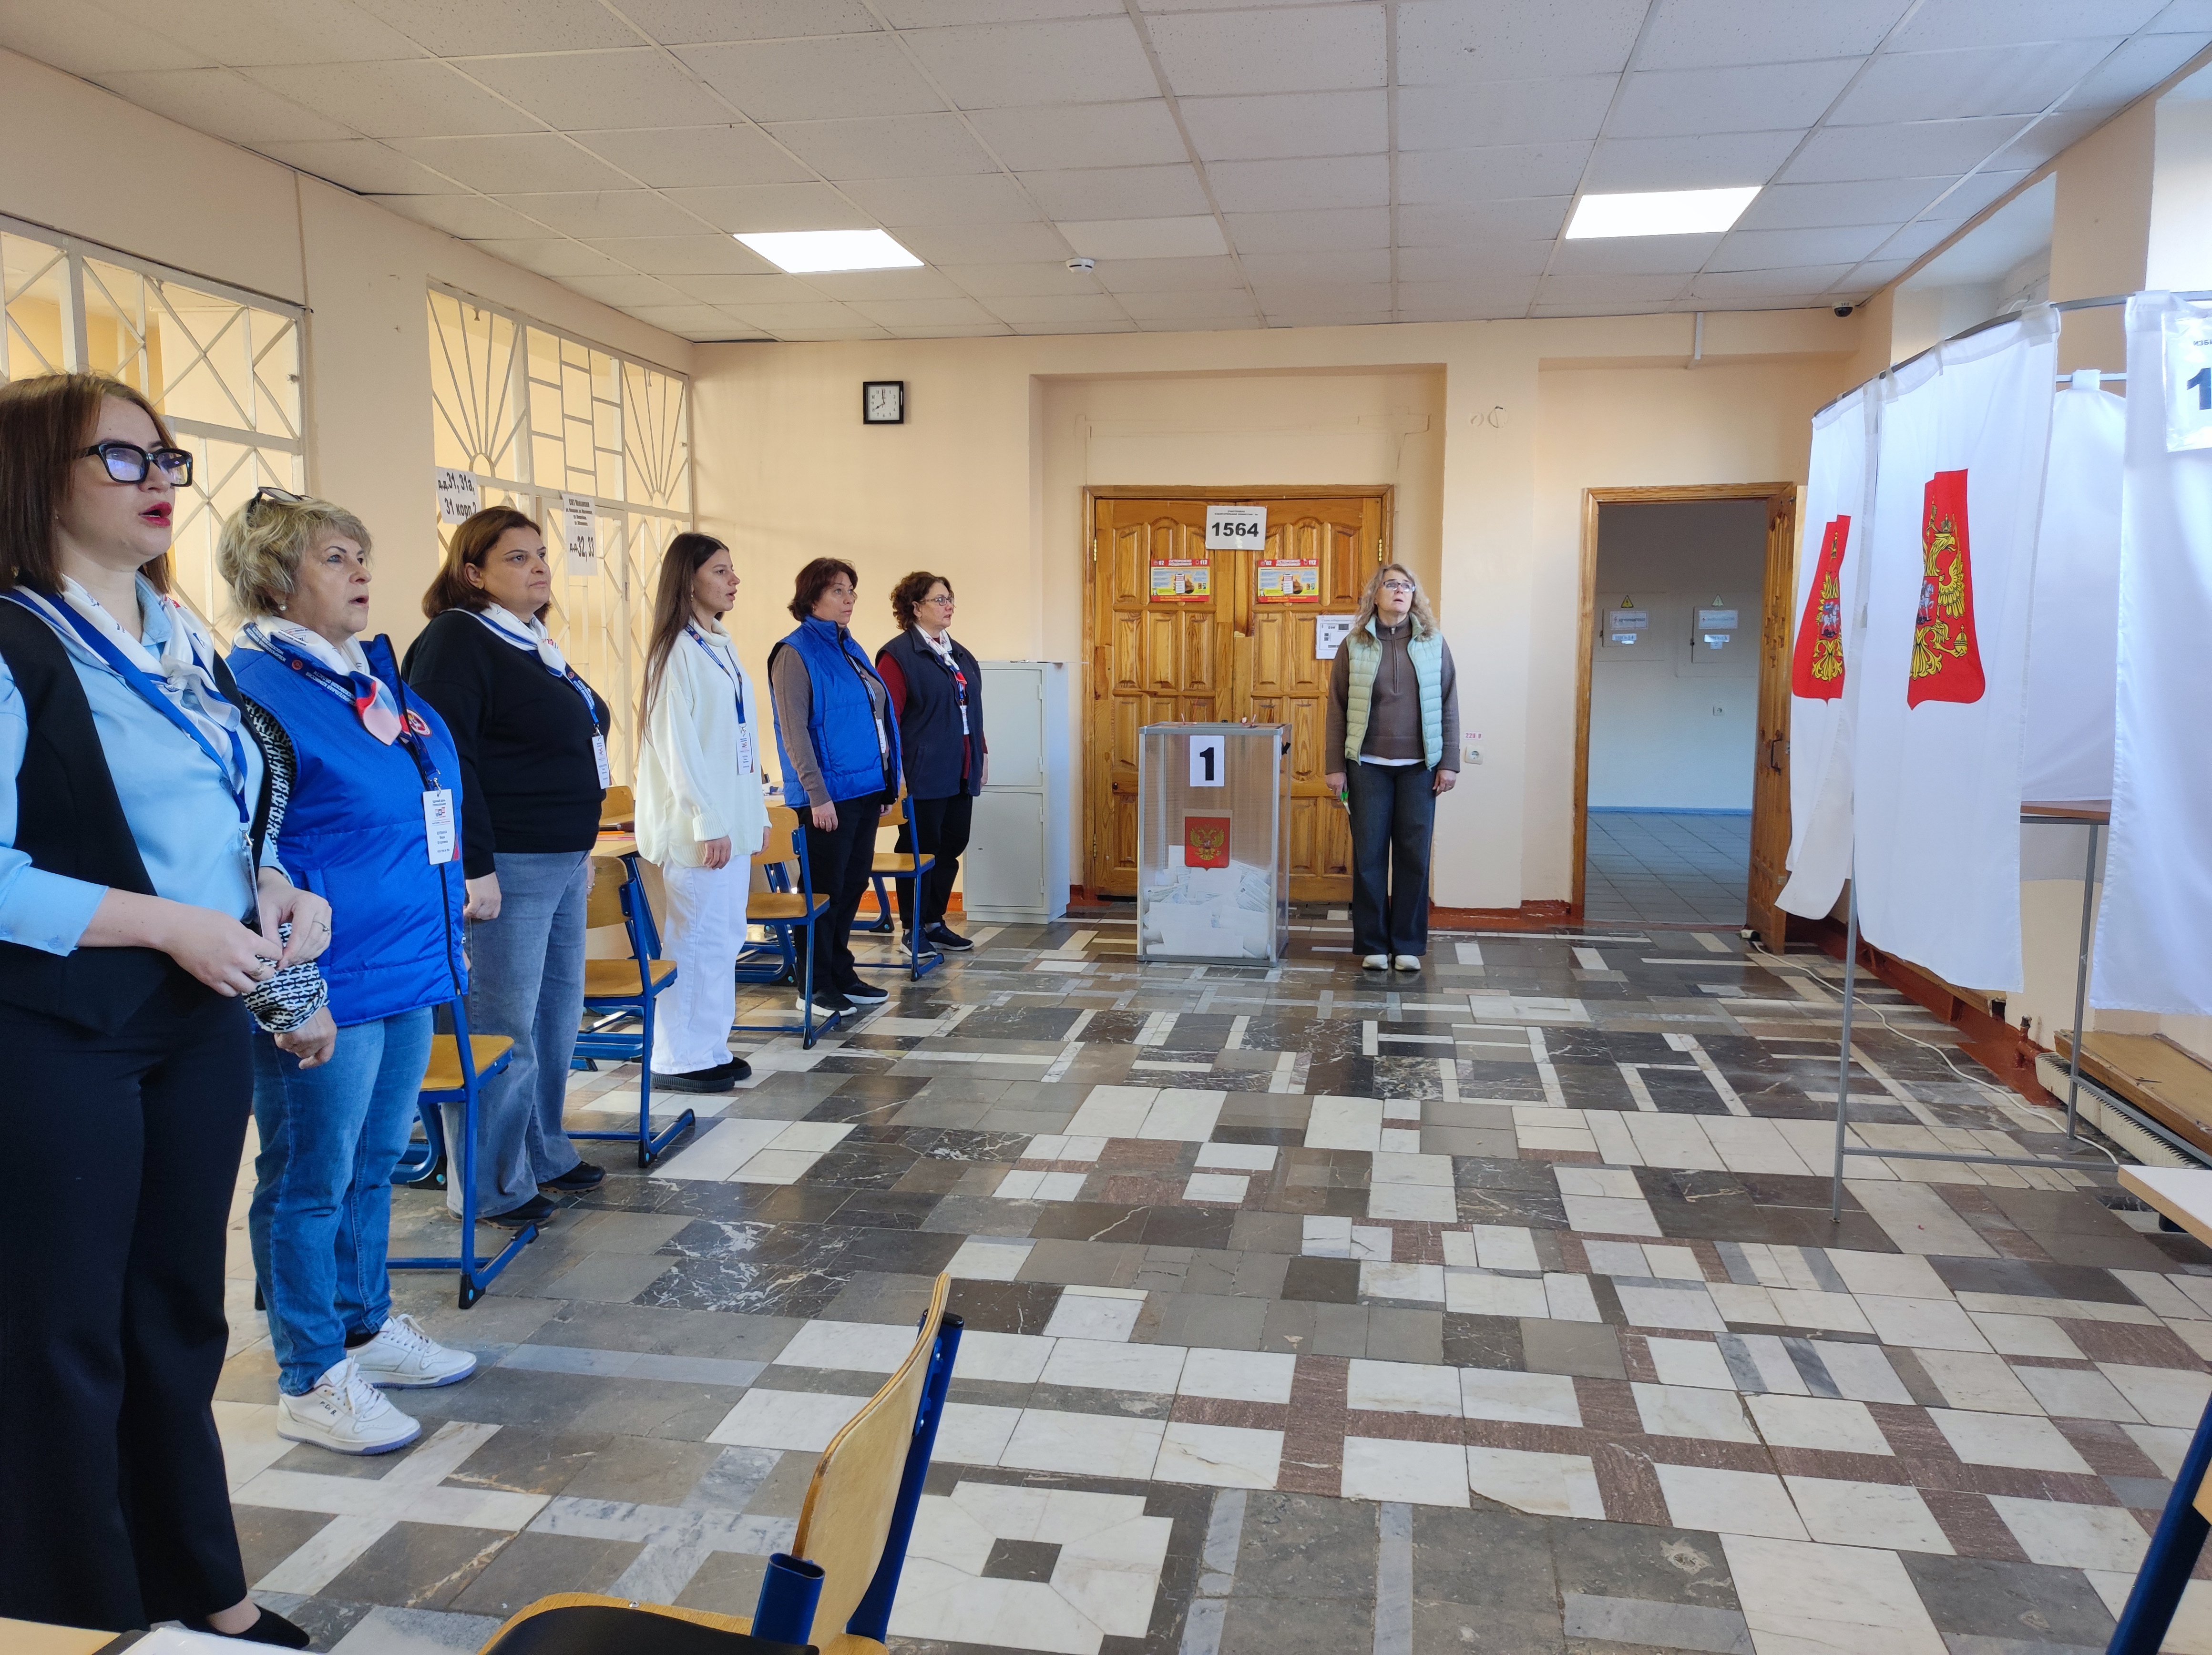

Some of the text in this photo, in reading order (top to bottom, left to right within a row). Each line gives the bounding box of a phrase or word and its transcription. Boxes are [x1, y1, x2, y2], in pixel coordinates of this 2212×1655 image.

[2187, 368, 2212, 410] 1
[459, 474, 475, 496] 31а,
[444, 498, 454, 515] 31
[1211, 522, 1259, 537] 1564
[588, 536, 594, 558] 33
[1199, 747, 1214, 781] 1
